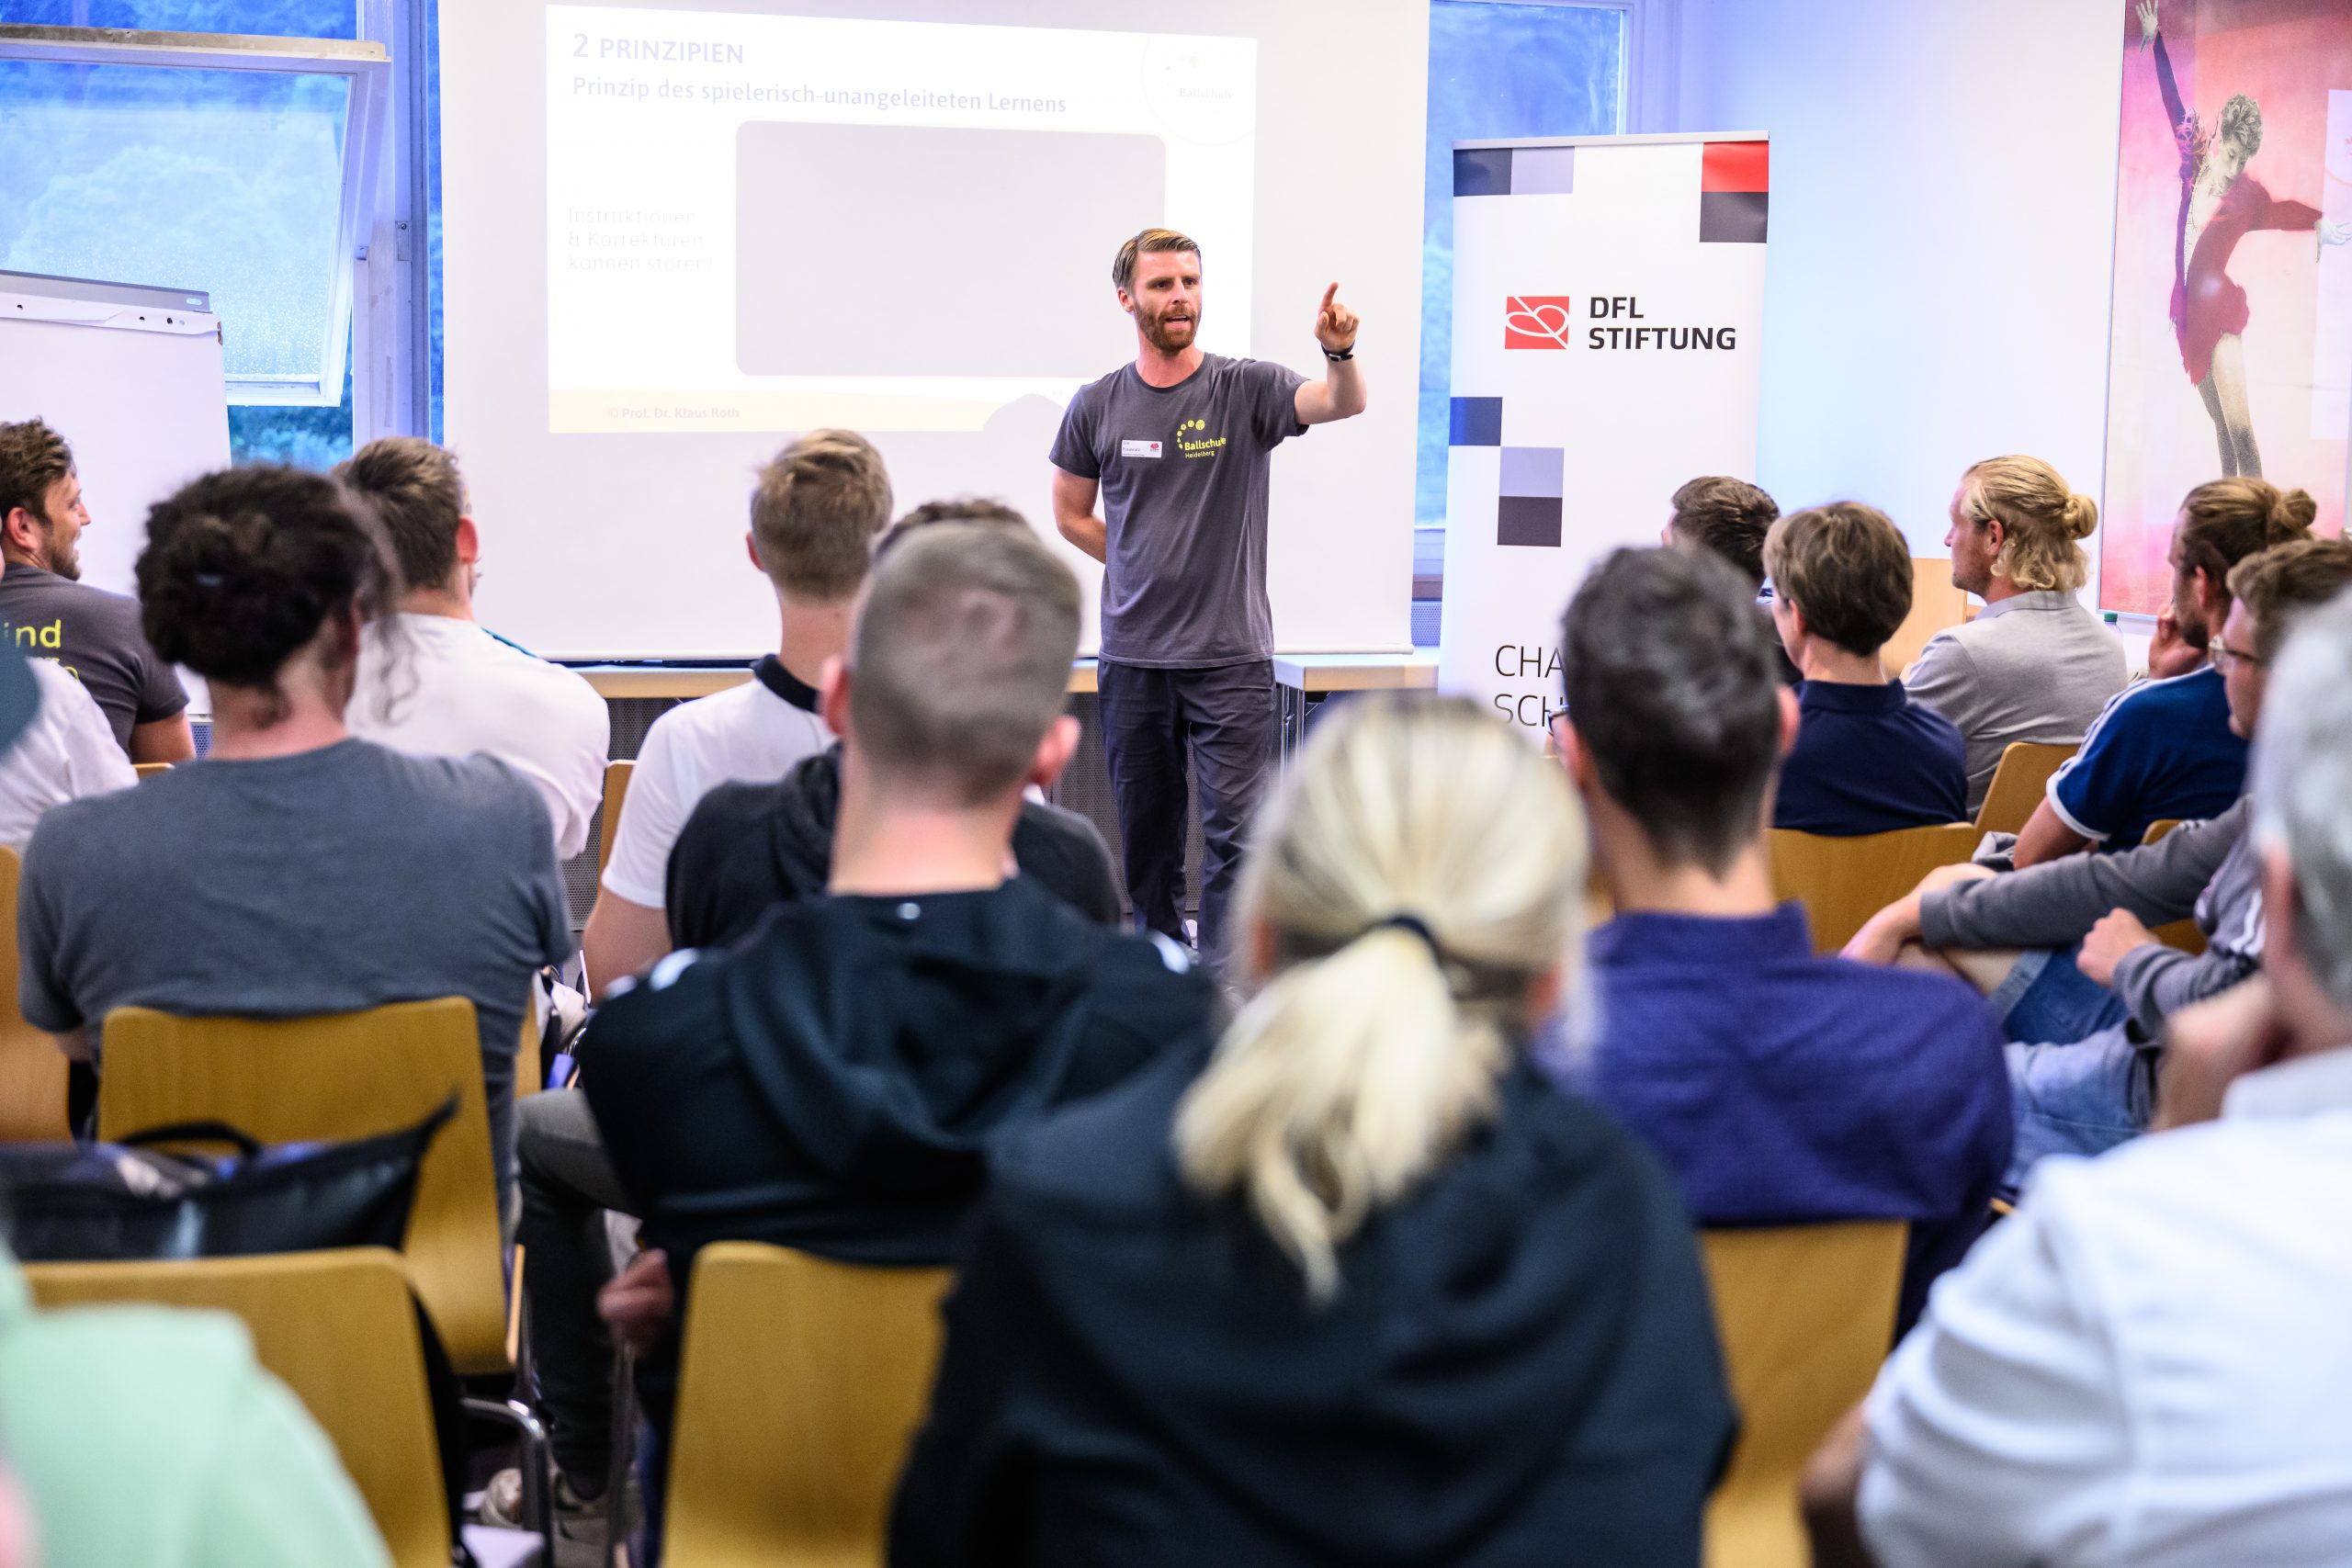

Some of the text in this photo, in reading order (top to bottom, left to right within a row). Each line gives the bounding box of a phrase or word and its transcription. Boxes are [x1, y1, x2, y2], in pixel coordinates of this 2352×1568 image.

[572, 34, 744, 63] 2 PRINZIPIEN
[572, 77, 1068, 113] Prinzip des spielerisch-unangeleiteten Lernens
[1589, 296, 1645, 321] DFL
[1589, 327, 1736, 351] STIFTUNG
[654, 407, 671, 420] Dr.
[675, 407, 707, 420] Klaus
[711, 407, 740, 420] Roth
[1185, 450, 1215, 458] Heidelberg
